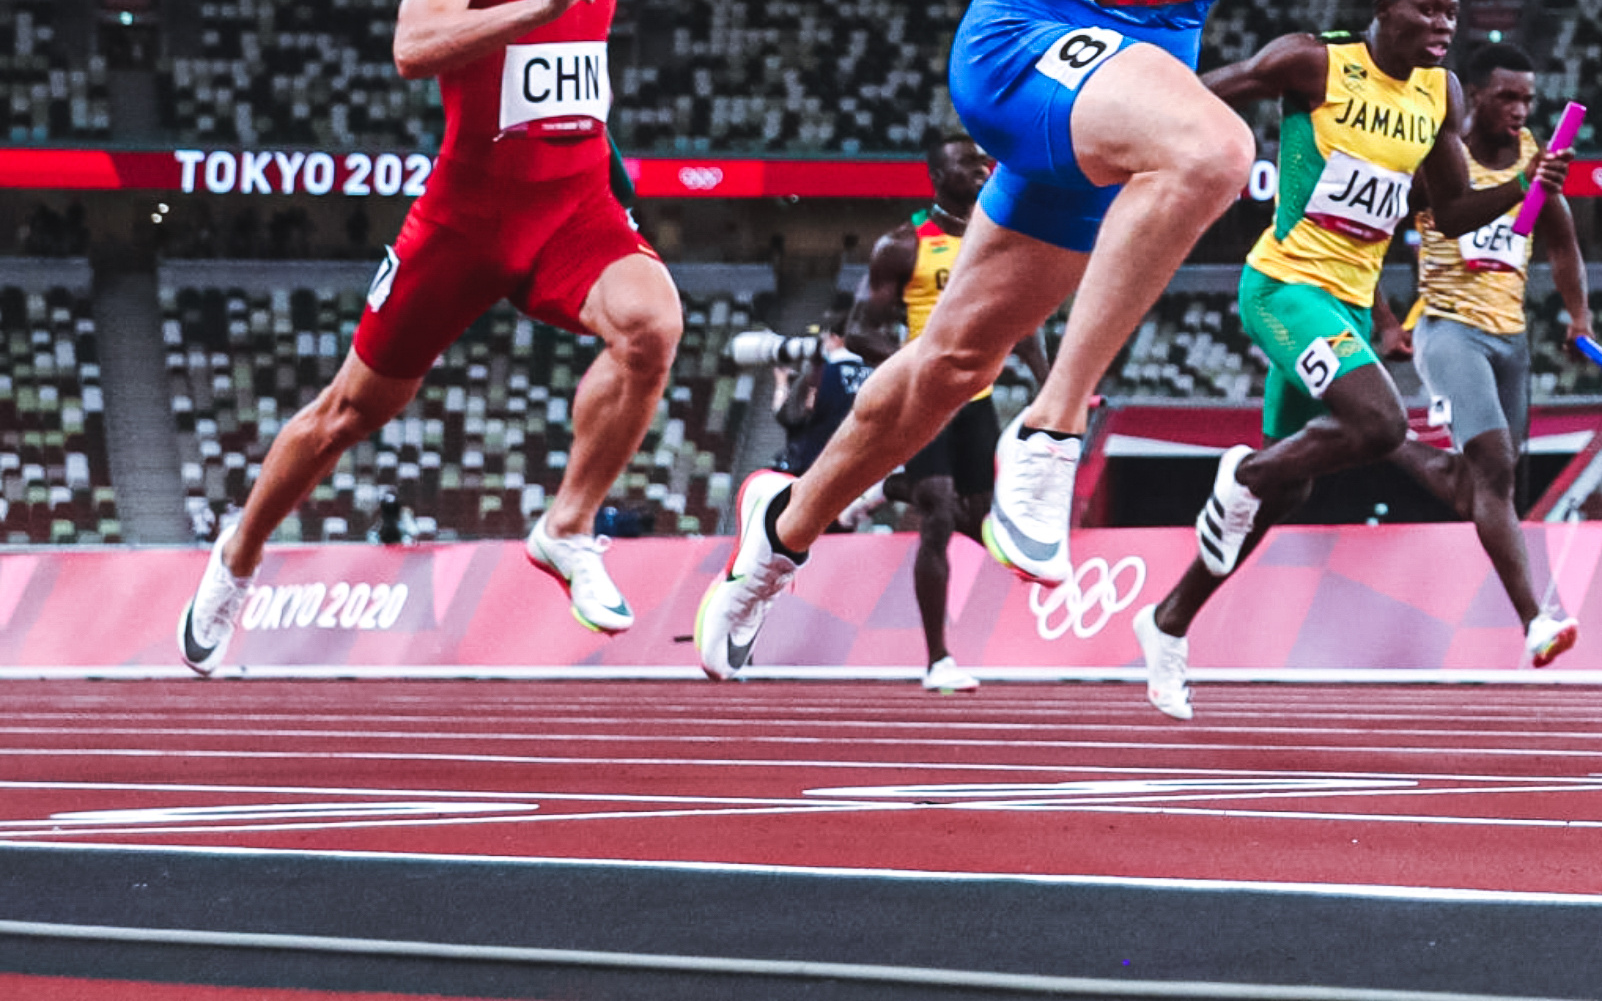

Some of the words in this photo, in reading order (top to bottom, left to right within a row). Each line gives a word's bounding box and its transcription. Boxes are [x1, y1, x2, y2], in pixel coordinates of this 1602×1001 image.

[1059, 34, 1107, 69] 8
[523, 55, 599, 103] CHN
[174, 149, 335, 195] TOKYO
[342, 152, 438, 197] 202
[1301, 350, 1329, 388] 5
[242, 583, 327, 630] OKYO
[316, 582, 409, 629] 2020
